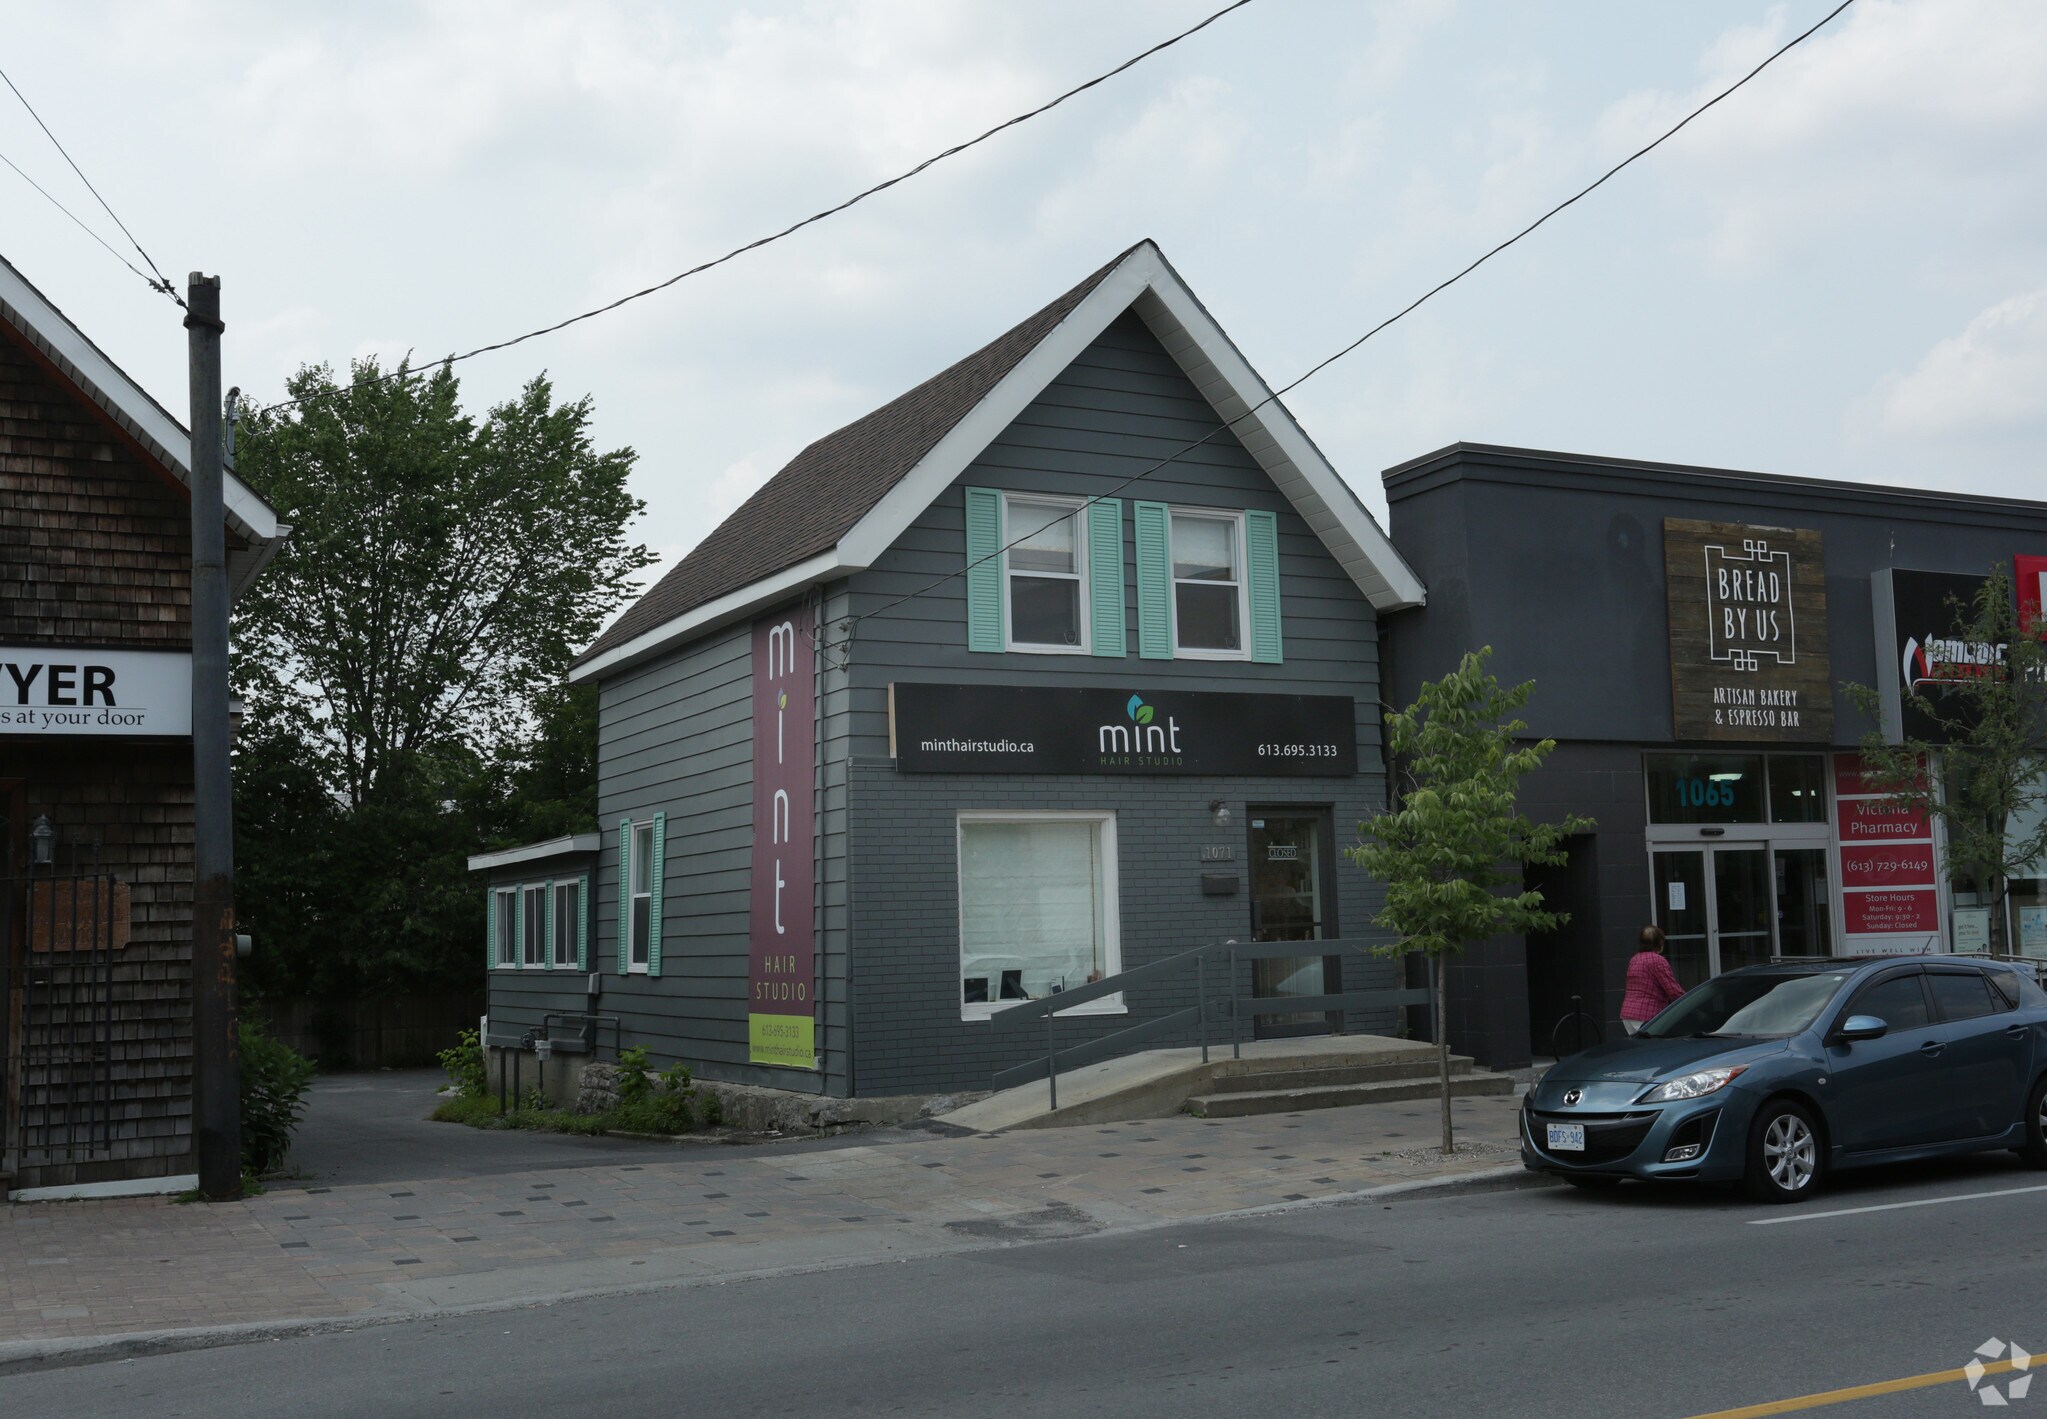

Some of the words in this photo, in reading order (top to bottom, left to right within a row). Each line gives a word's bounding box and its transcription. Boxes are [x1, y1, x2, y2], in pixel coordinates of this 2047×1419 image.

[1718, 568, 1780, 603] BREAD
[1724, 607, 1747, 640] BY
[1756, 609, 1780, 642] US
[0, 663, 117, 707] YER
[1713, 687, 1755, 706] ARTISAN
[1760, 689, 1798, 706] BAKERY
[16, 709, 36, 724] at
[41, 712, 91, 730] your
[97, 708, 145, 726] door
[1714, 709, 1724, 725] &
[1728, 709, 1775, 727] ESPRESSO
[1780, 711, 1800, 727] BAR
[1099, 716, 1182, 754] mint
[921, 738, 1035, 753] minthairstudio.ca
[1257, 744, 1338, 757] 613.695.3133
[1100, 756, 1130, 766] HAIR
[1138, 756, 1183, 766] STUDIO
[768, 620, 795, 935] mint
[1675, 777, 1735, 807] 1065
[1851, 821, 1918, 835] Pharmacy
[1204, 846, 1232, 859] 1071
[1268, 848, 1297, 858] CLOSED
[1846, 859, 1874, 873] (613)
[1877, 859, 1928, 872] 729-6149
[1865, 893, 1888, 902] Store
[1889, 893, 1915, 902] Hours
[1862, 913, 1895, 922] Saturday:
[1866, 922, 1894, 930] Sunday:
[1894, 921, 1918, 929] Closed
[765, 955, 796, 973] HAIR
[756, 982, 806, 1001] STUDIO
[761, 1024, 800, 1039] 613-695-3133
[1570, 1131, 1583, 1144] 942
